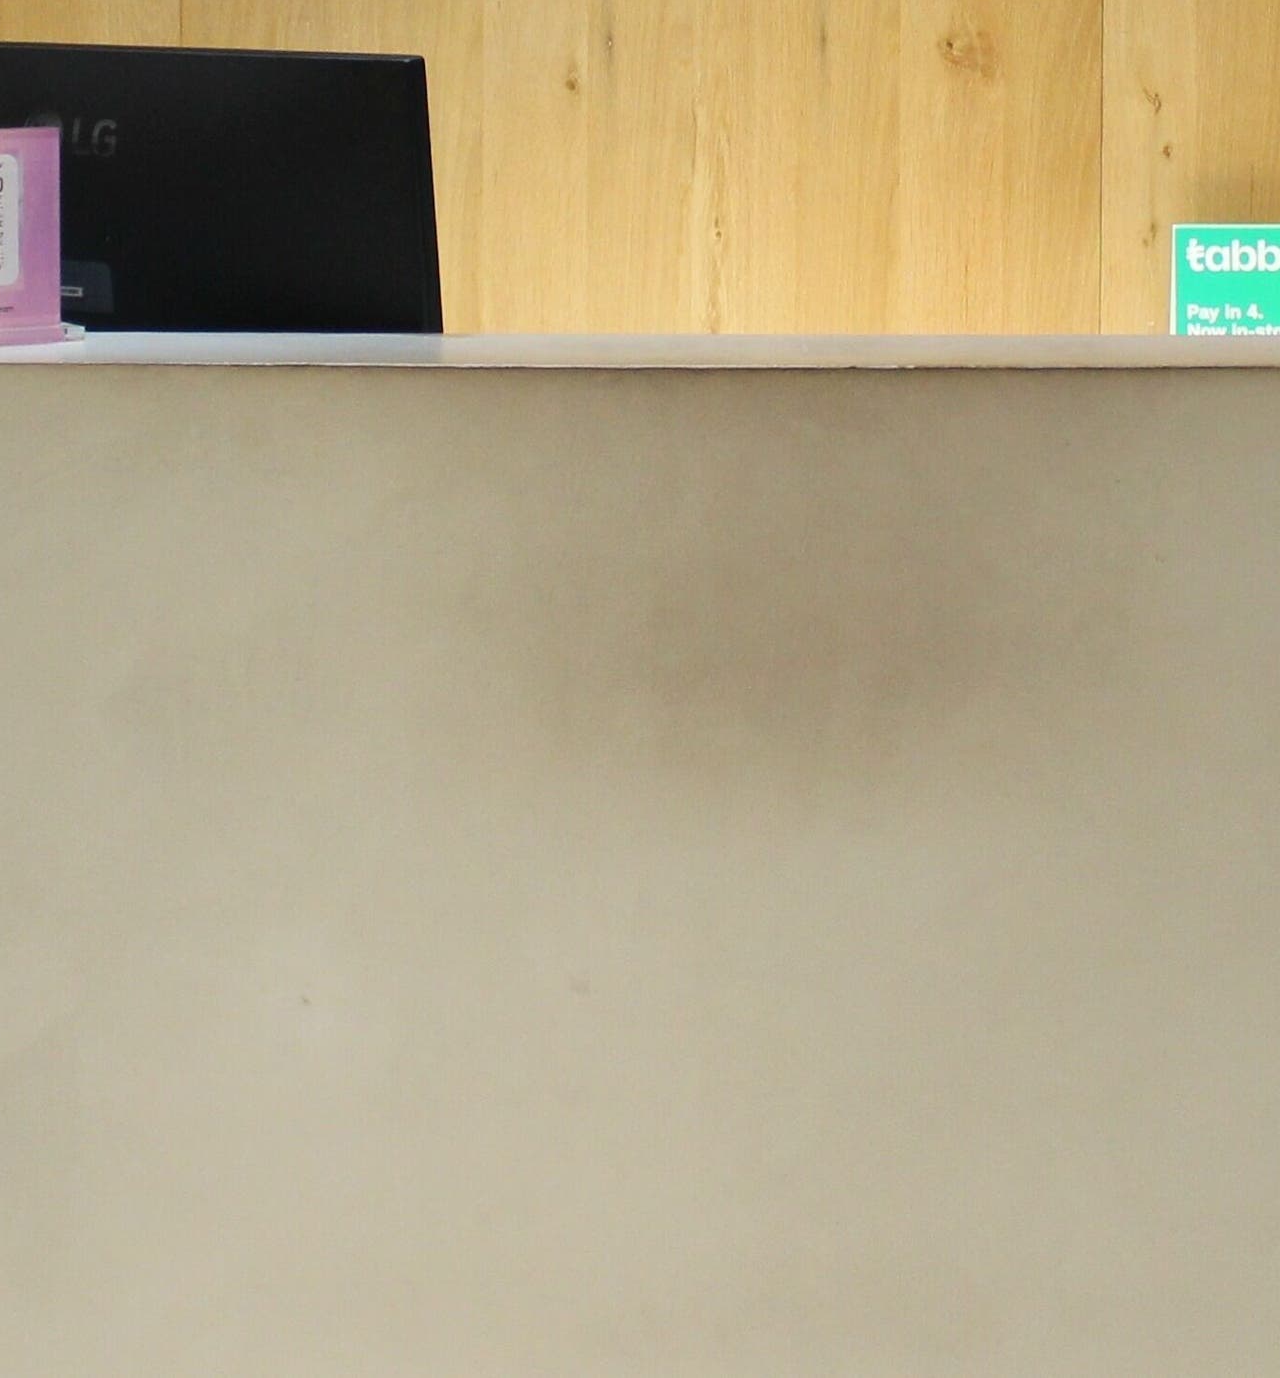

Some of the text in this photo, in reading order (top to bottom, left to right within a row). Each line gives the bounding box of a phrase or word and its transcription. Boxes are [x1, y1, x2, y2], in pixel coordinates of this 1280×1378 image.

[71, 117, 117, 157] LG
[1187, 303, 1264, 324] Pay in 4.
[1187, 322, 1227, 336] Now
